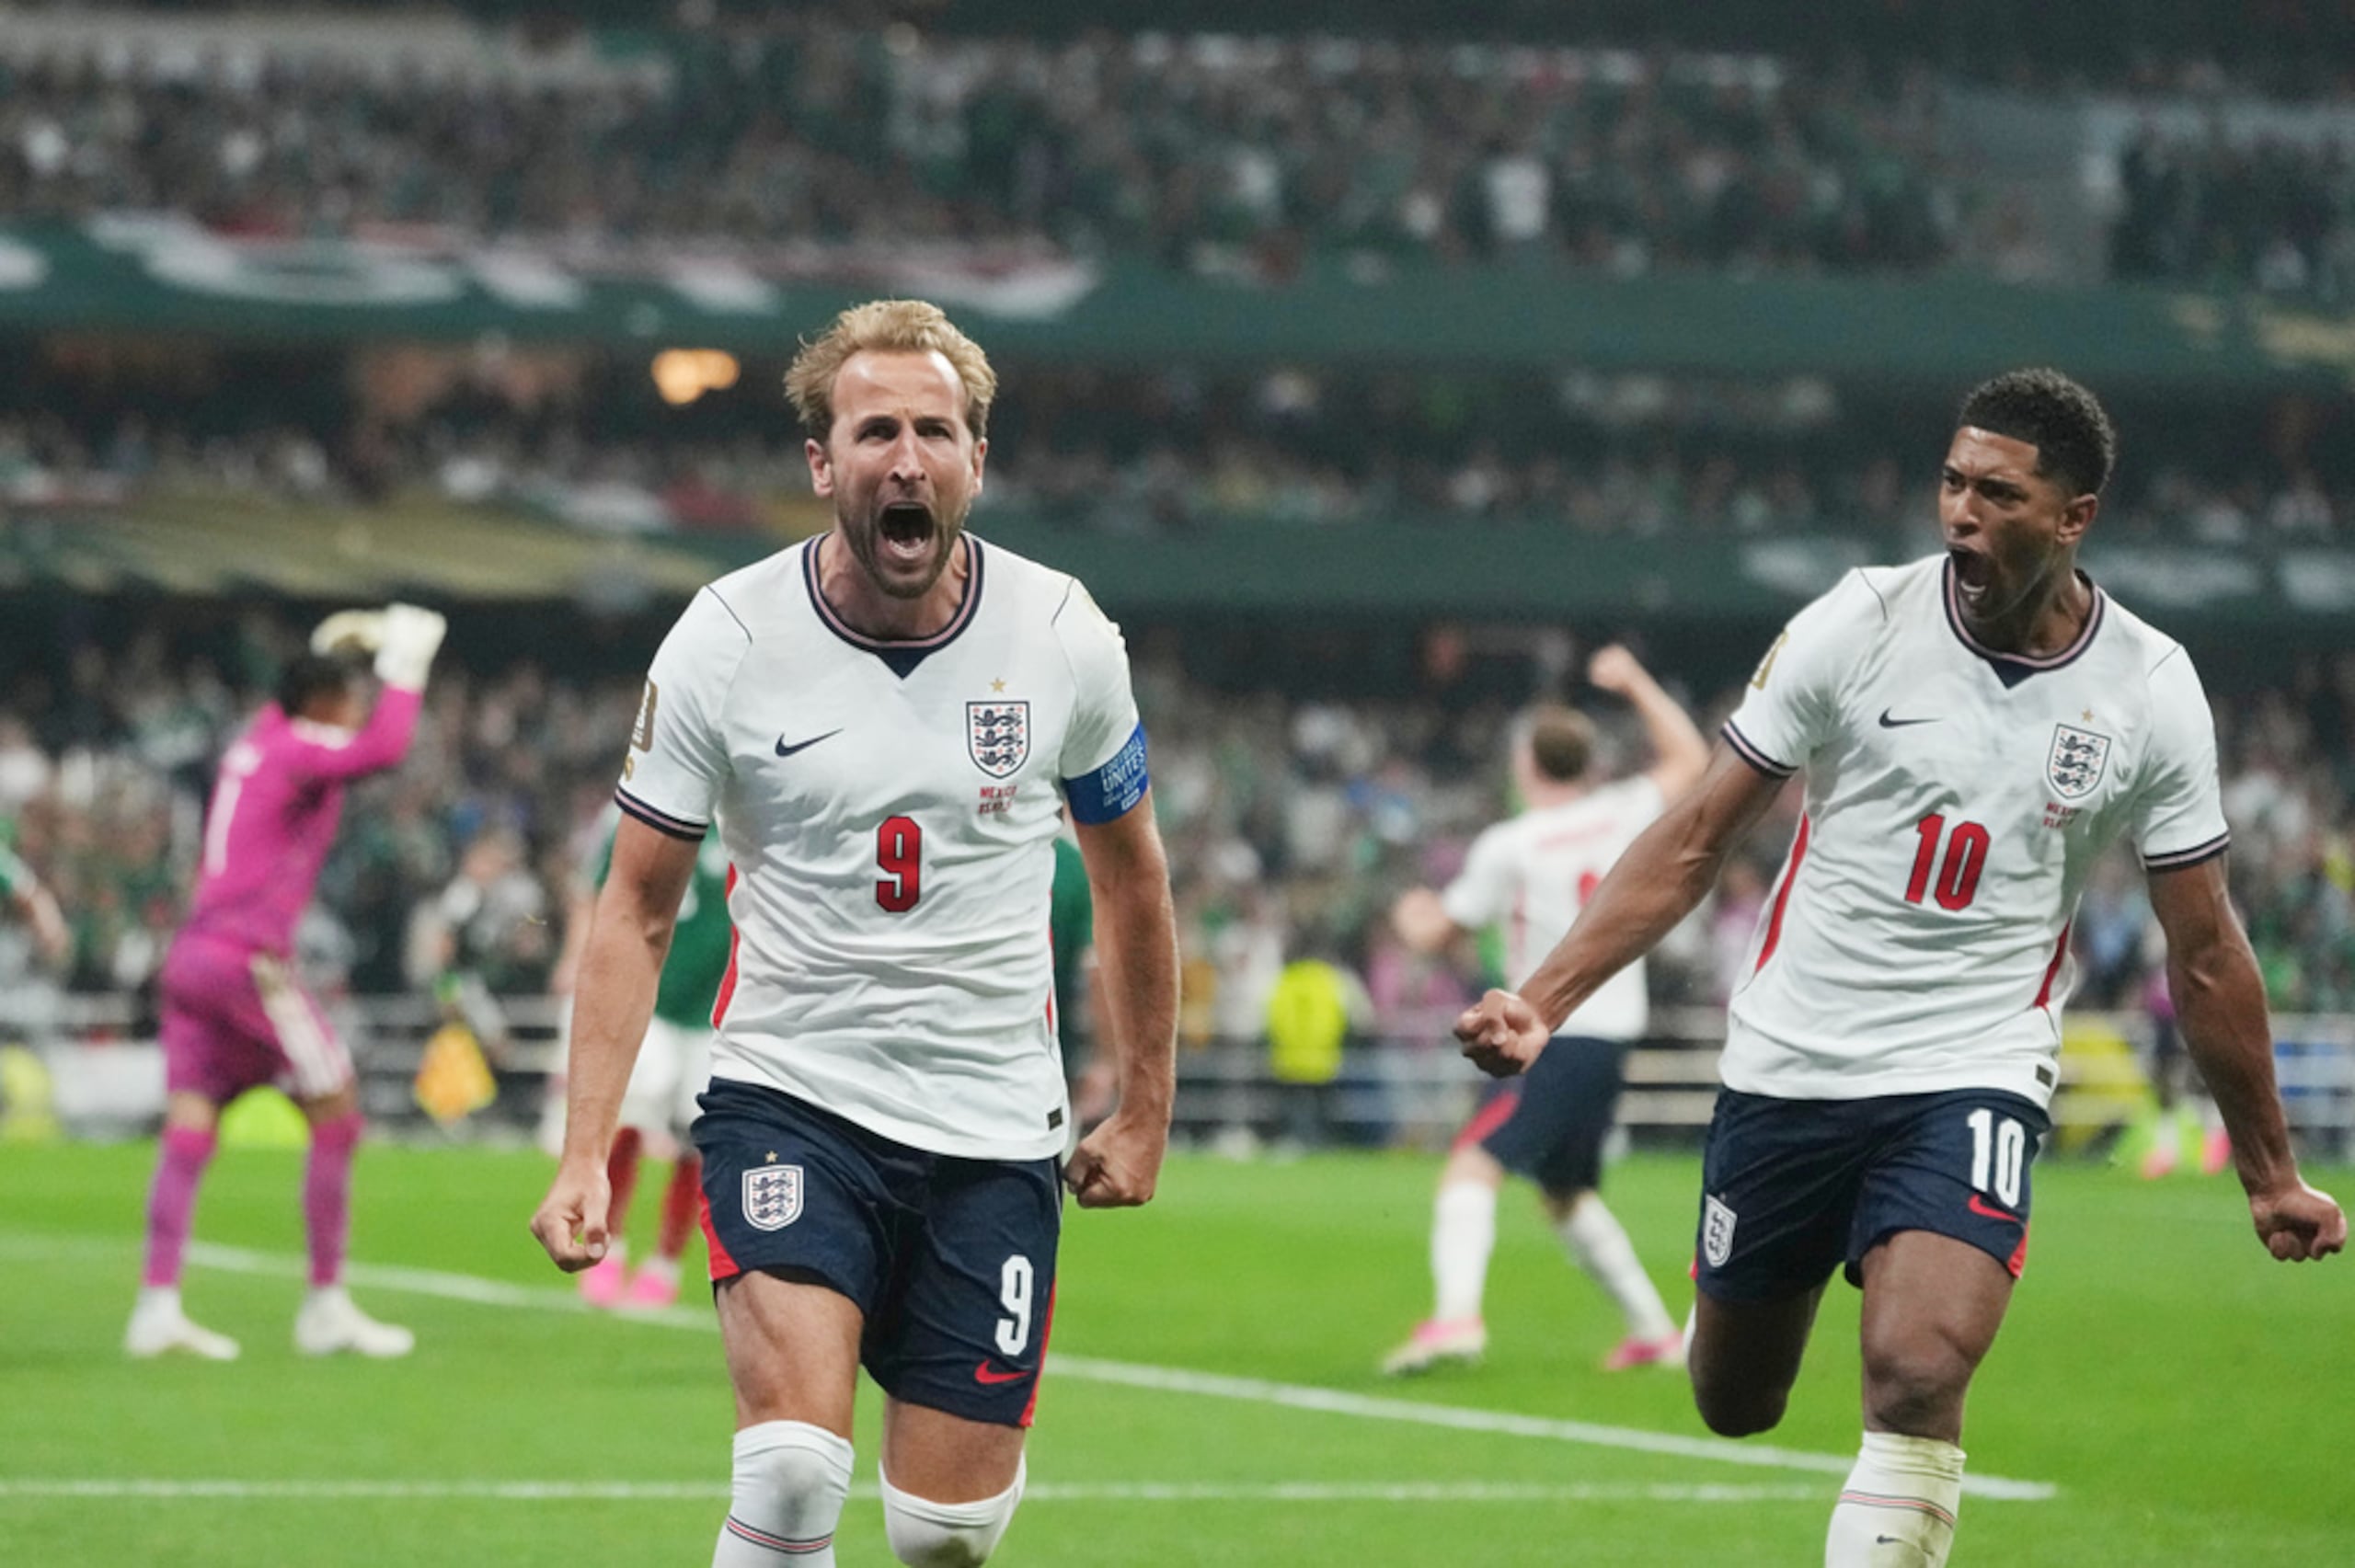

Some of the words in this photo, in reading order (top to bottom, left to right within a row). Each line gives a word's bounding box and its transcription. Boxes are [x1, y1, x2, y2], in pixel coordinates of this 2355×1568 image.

[876, 816, 922, 912] 9
[1904, 814, 1991, 912] 10
[1968, 1108, 2025, 1207] 10
[994, 1254, 1033, 1356] 9
